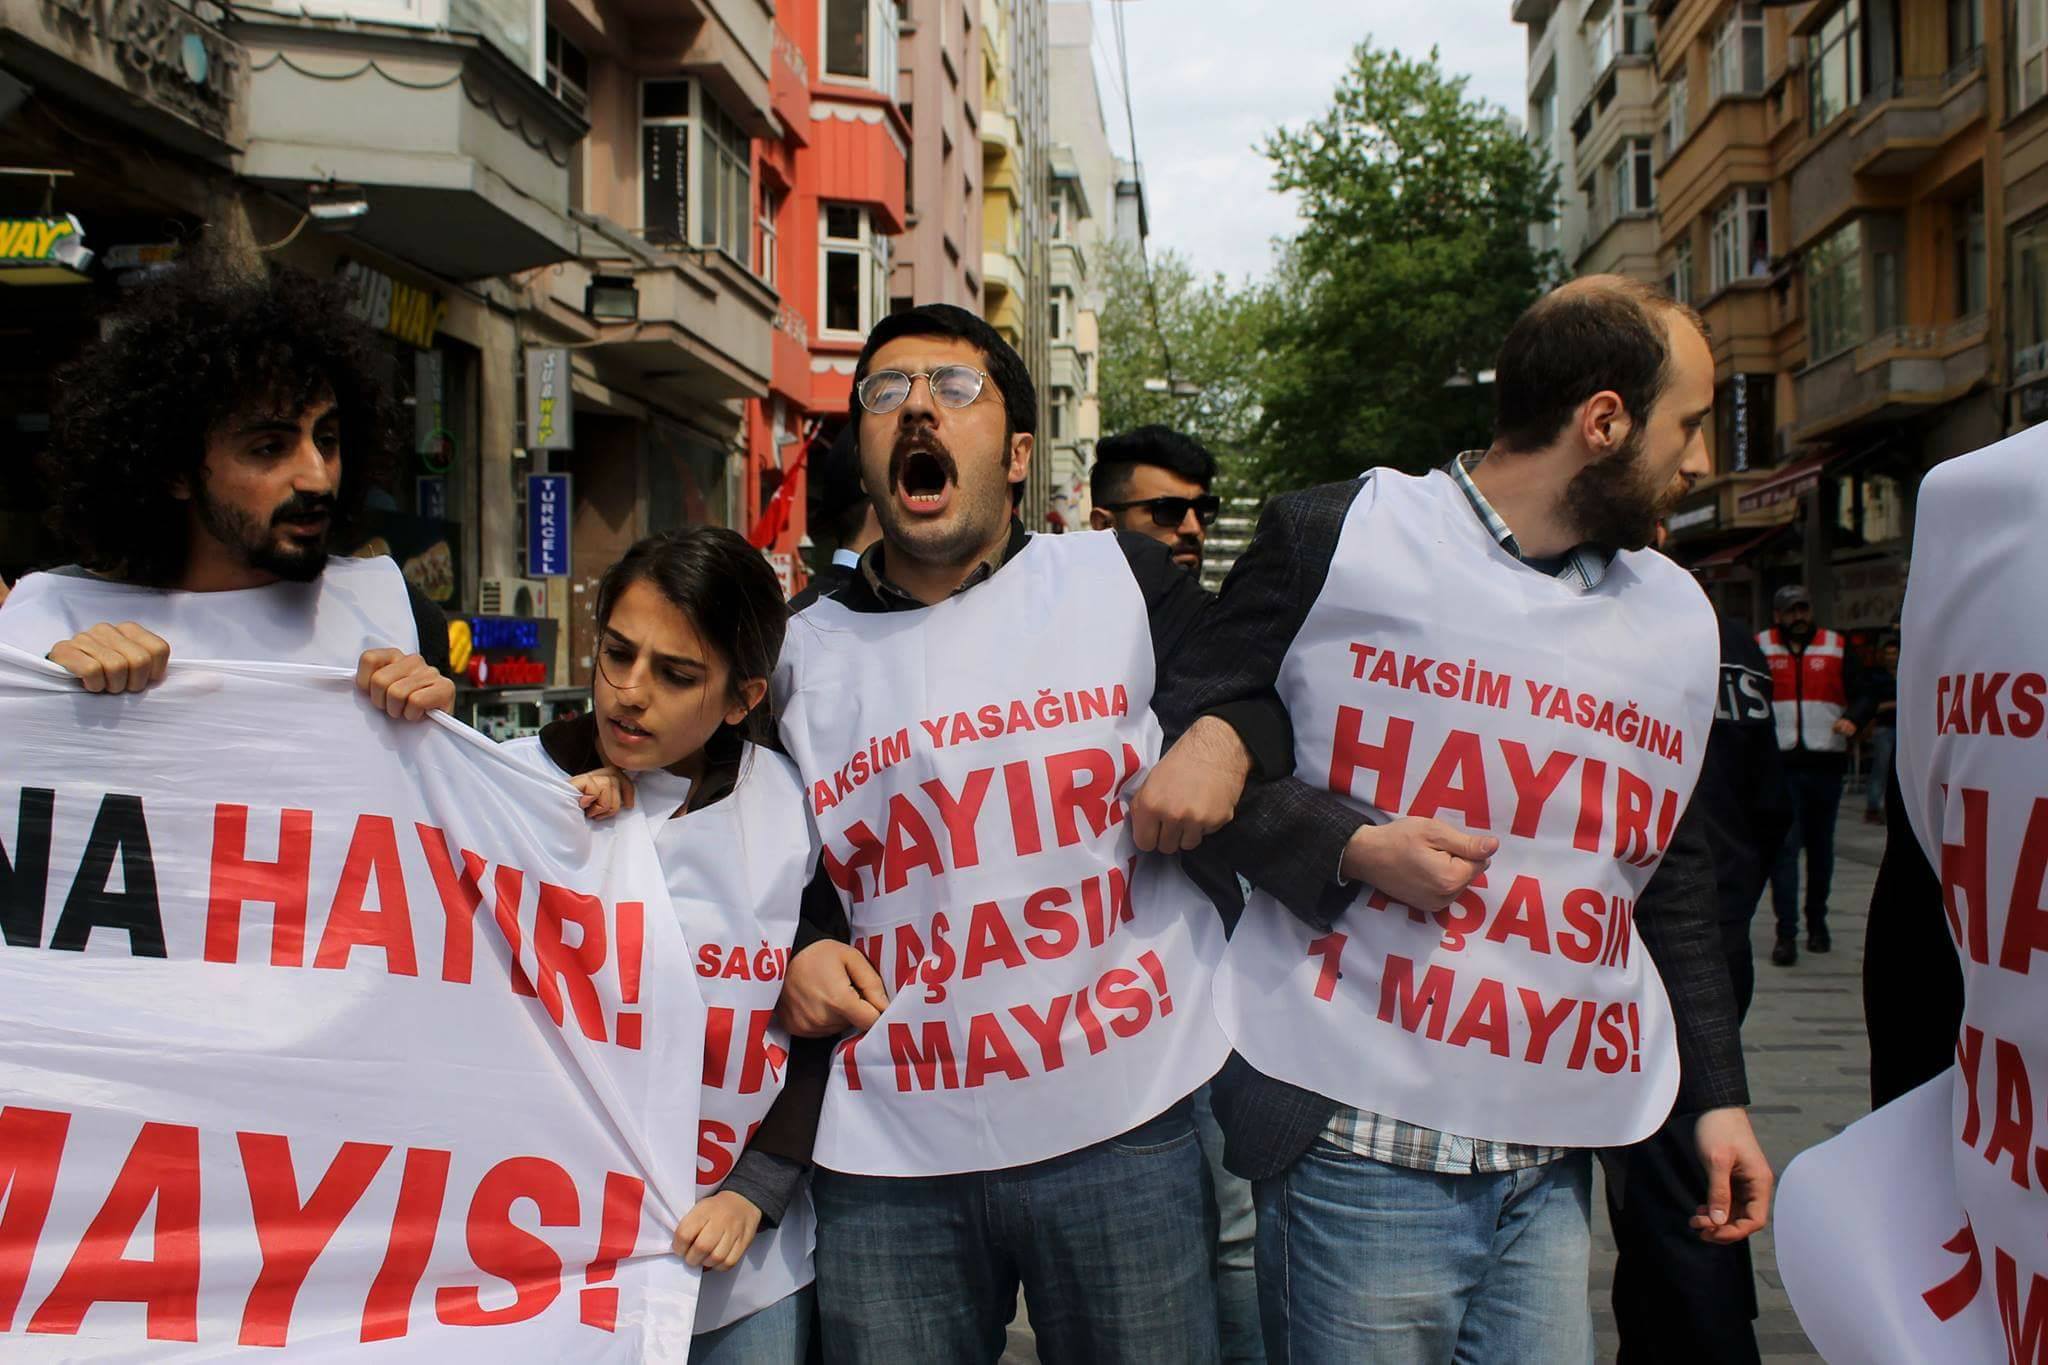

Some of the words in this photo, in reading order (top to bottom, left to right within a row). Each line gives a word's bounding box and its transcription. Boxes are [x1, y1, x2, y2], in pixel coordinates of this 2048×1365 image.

[538, 351, 555, 447] SUBWAY
[541, 479, 556, 574] TURKCELL
[806, 728, 911, 816] AKSİM
[920, 684, 1129, 750] YASAĞINA
[1350, 642, 1511, 709] TAKSİM
[1525, 680, 1684, 765] YASAĞINA
[1328, 704, 1679, 868] HAYIR!
[203, 803, 646, 1051] HAYIR!
[887, 950, 1174, 1093] MAYIS!
[1307, 931, 1348, 1002] 1
[1376, 953, 1641, 1074] MAYIS!
